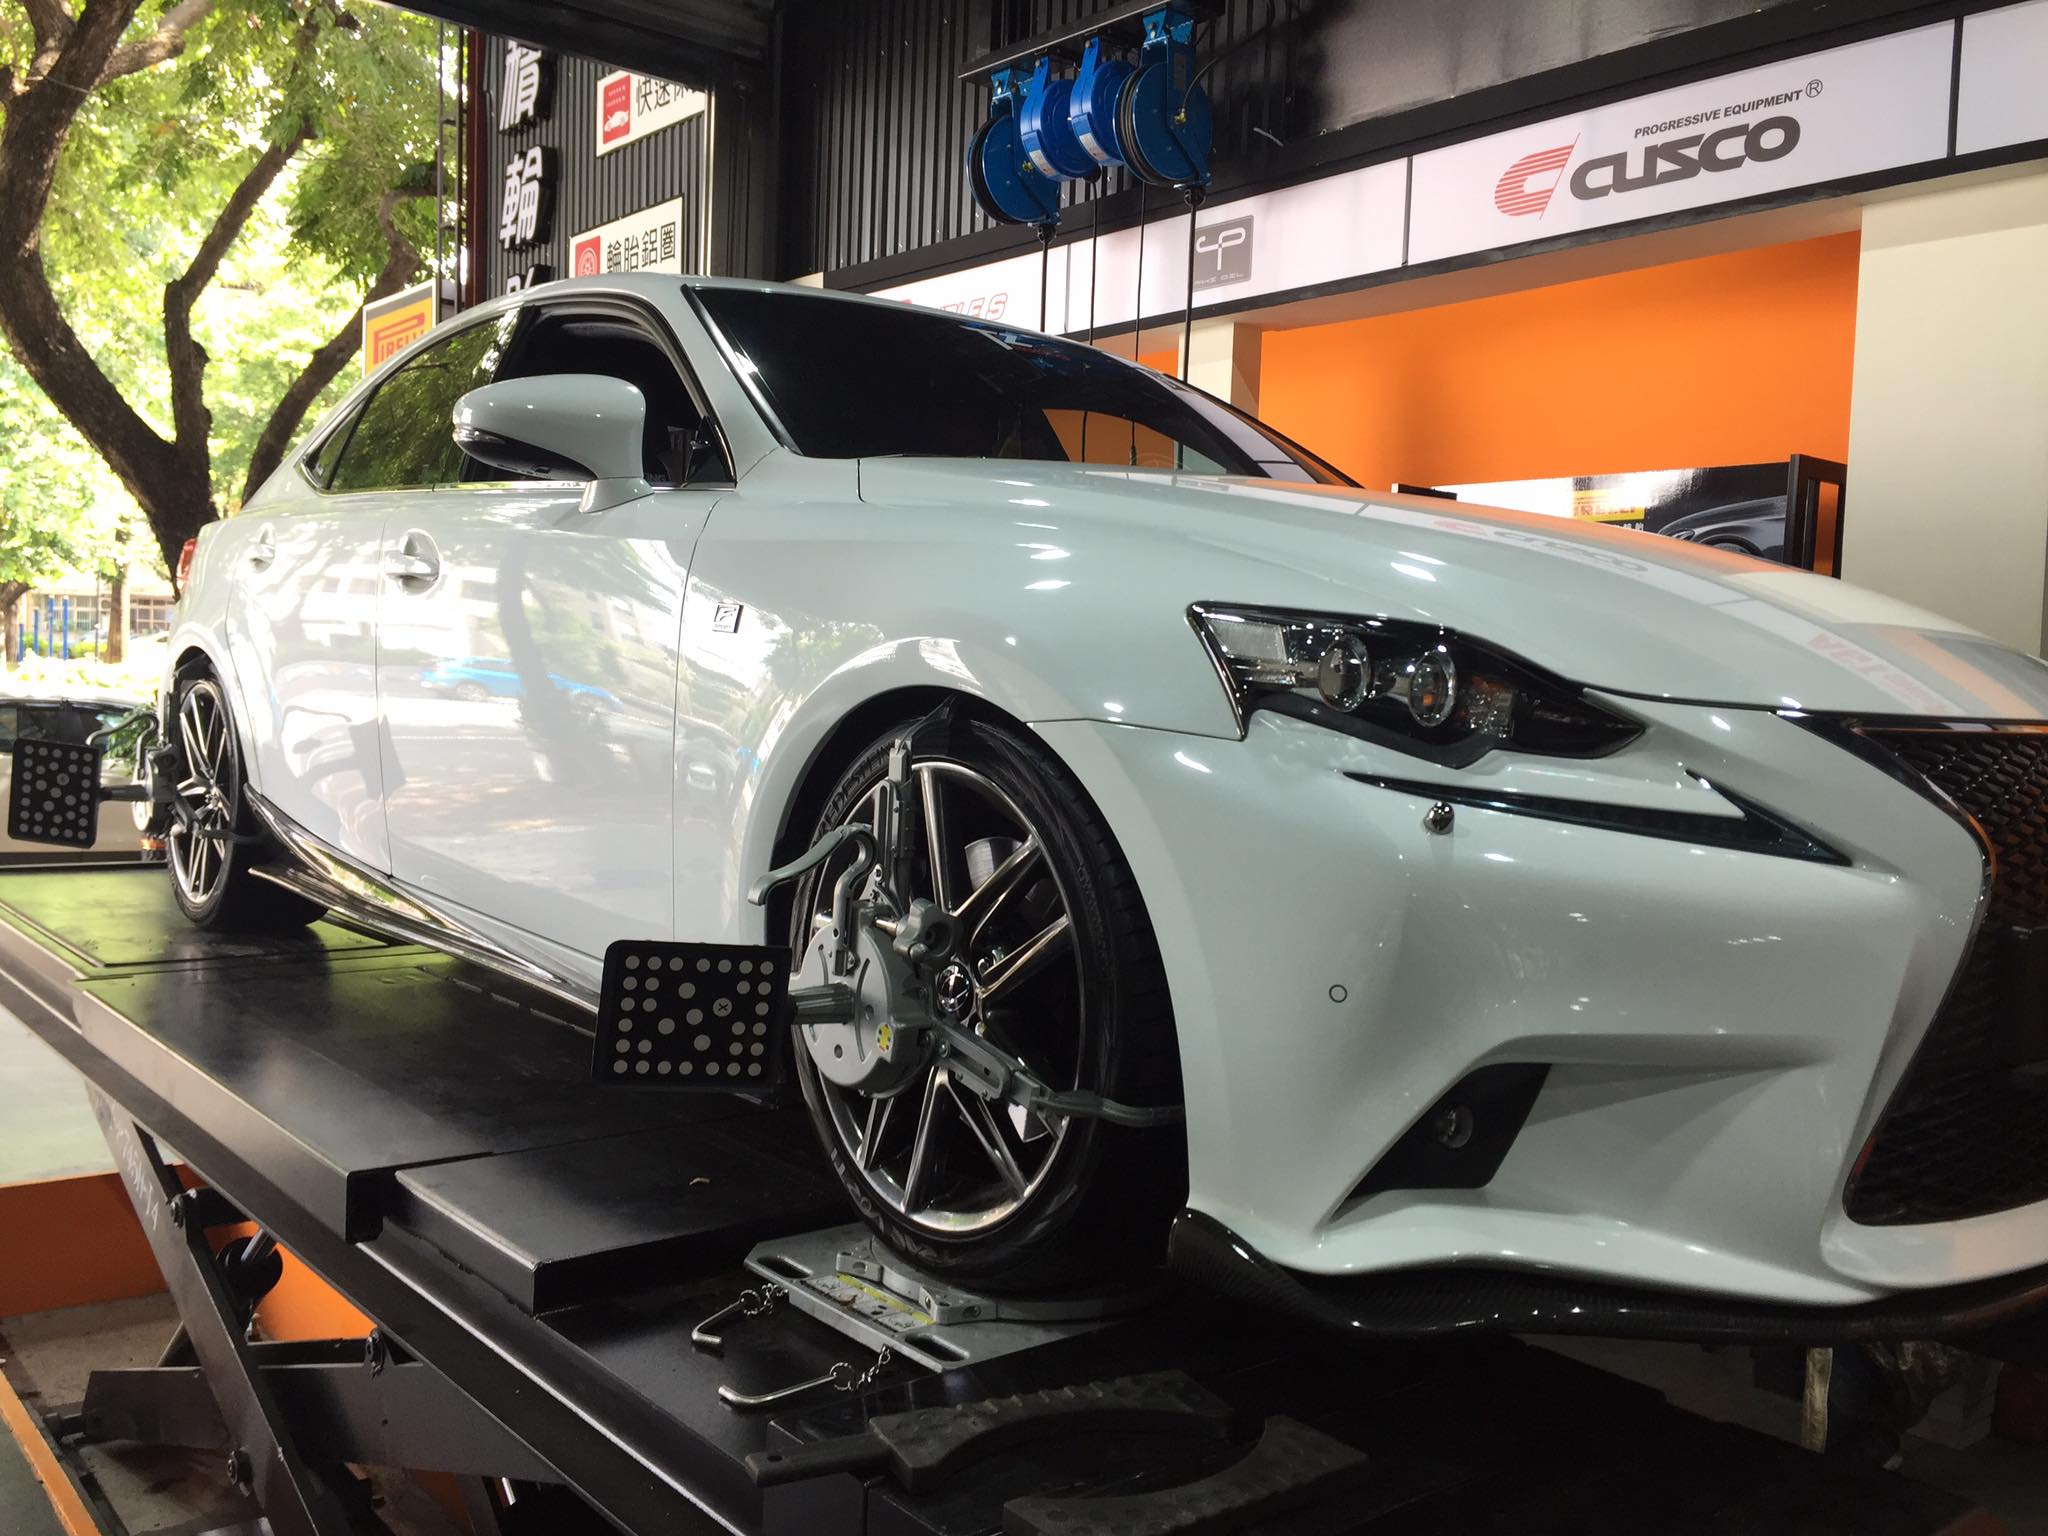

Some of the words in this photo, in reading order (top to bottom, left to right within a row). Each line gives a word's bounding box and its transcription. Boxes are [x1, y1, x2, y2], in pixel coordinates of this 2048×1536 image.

[1634, 109, 1721, 139] PROGRESSIVE
[1723, 89, 1803, 117] EQUIPMENT
[1570, 116, 1801, 200] CUSCO
